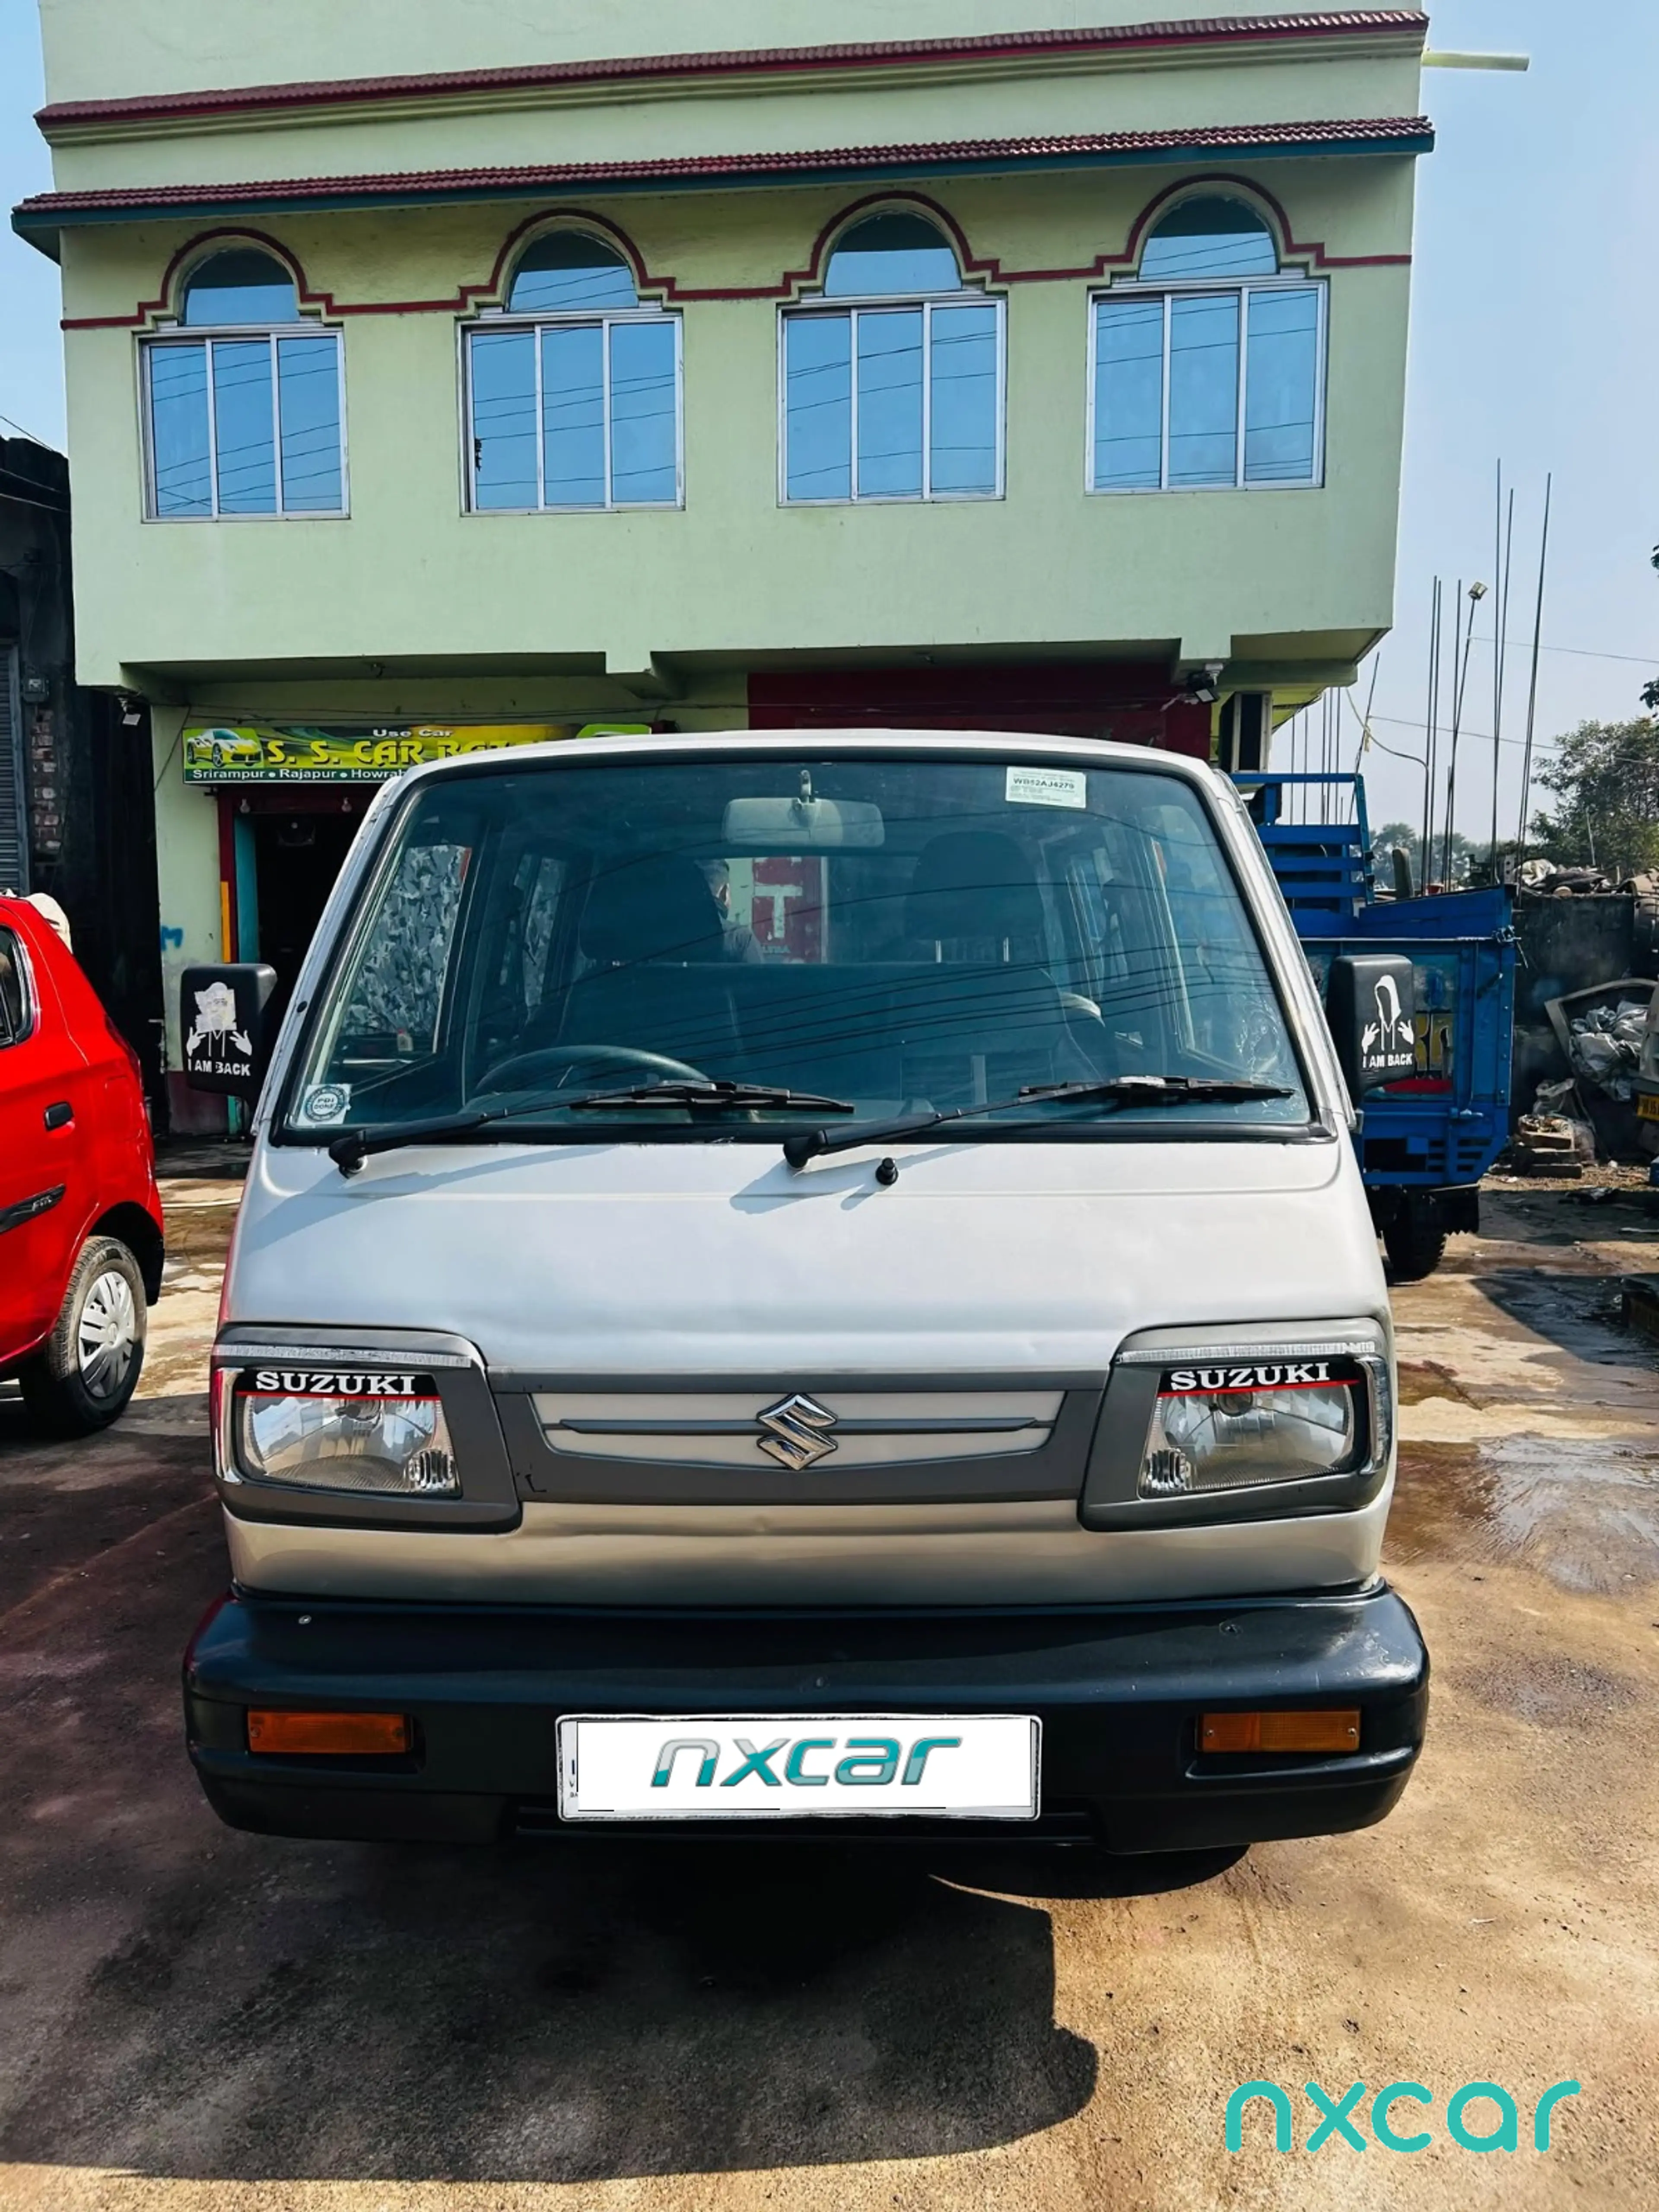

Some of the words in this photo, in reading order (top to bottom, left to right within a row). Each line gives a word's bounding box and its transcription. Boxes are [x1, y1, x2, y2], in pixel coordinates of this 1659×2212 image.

[373, 729, 412, 737] Use
[419, 728, 453, 737] Car
[268, 741, 296, 763] S.
[311, 741, 340, 763] S.
[353, 741, 425, 765] CAR
[193, 769, 265, 781] Srirampur
[280, 769, 337, 780] Rajapur
[188, 1058, 192, 1072] I
[194, 1059, 213, 1073] AM
[216, 1061, 251, 1076] BACK
[1363, 1056, 1367, 1068] I
[1369, 1055, 1385, 1068] AM
[1388, 1053, 1413, 1066] BACK
[256, 1371, 416, 1395] SUZUKI
[1170, 1362, 1330, 1391] SUZUKI
